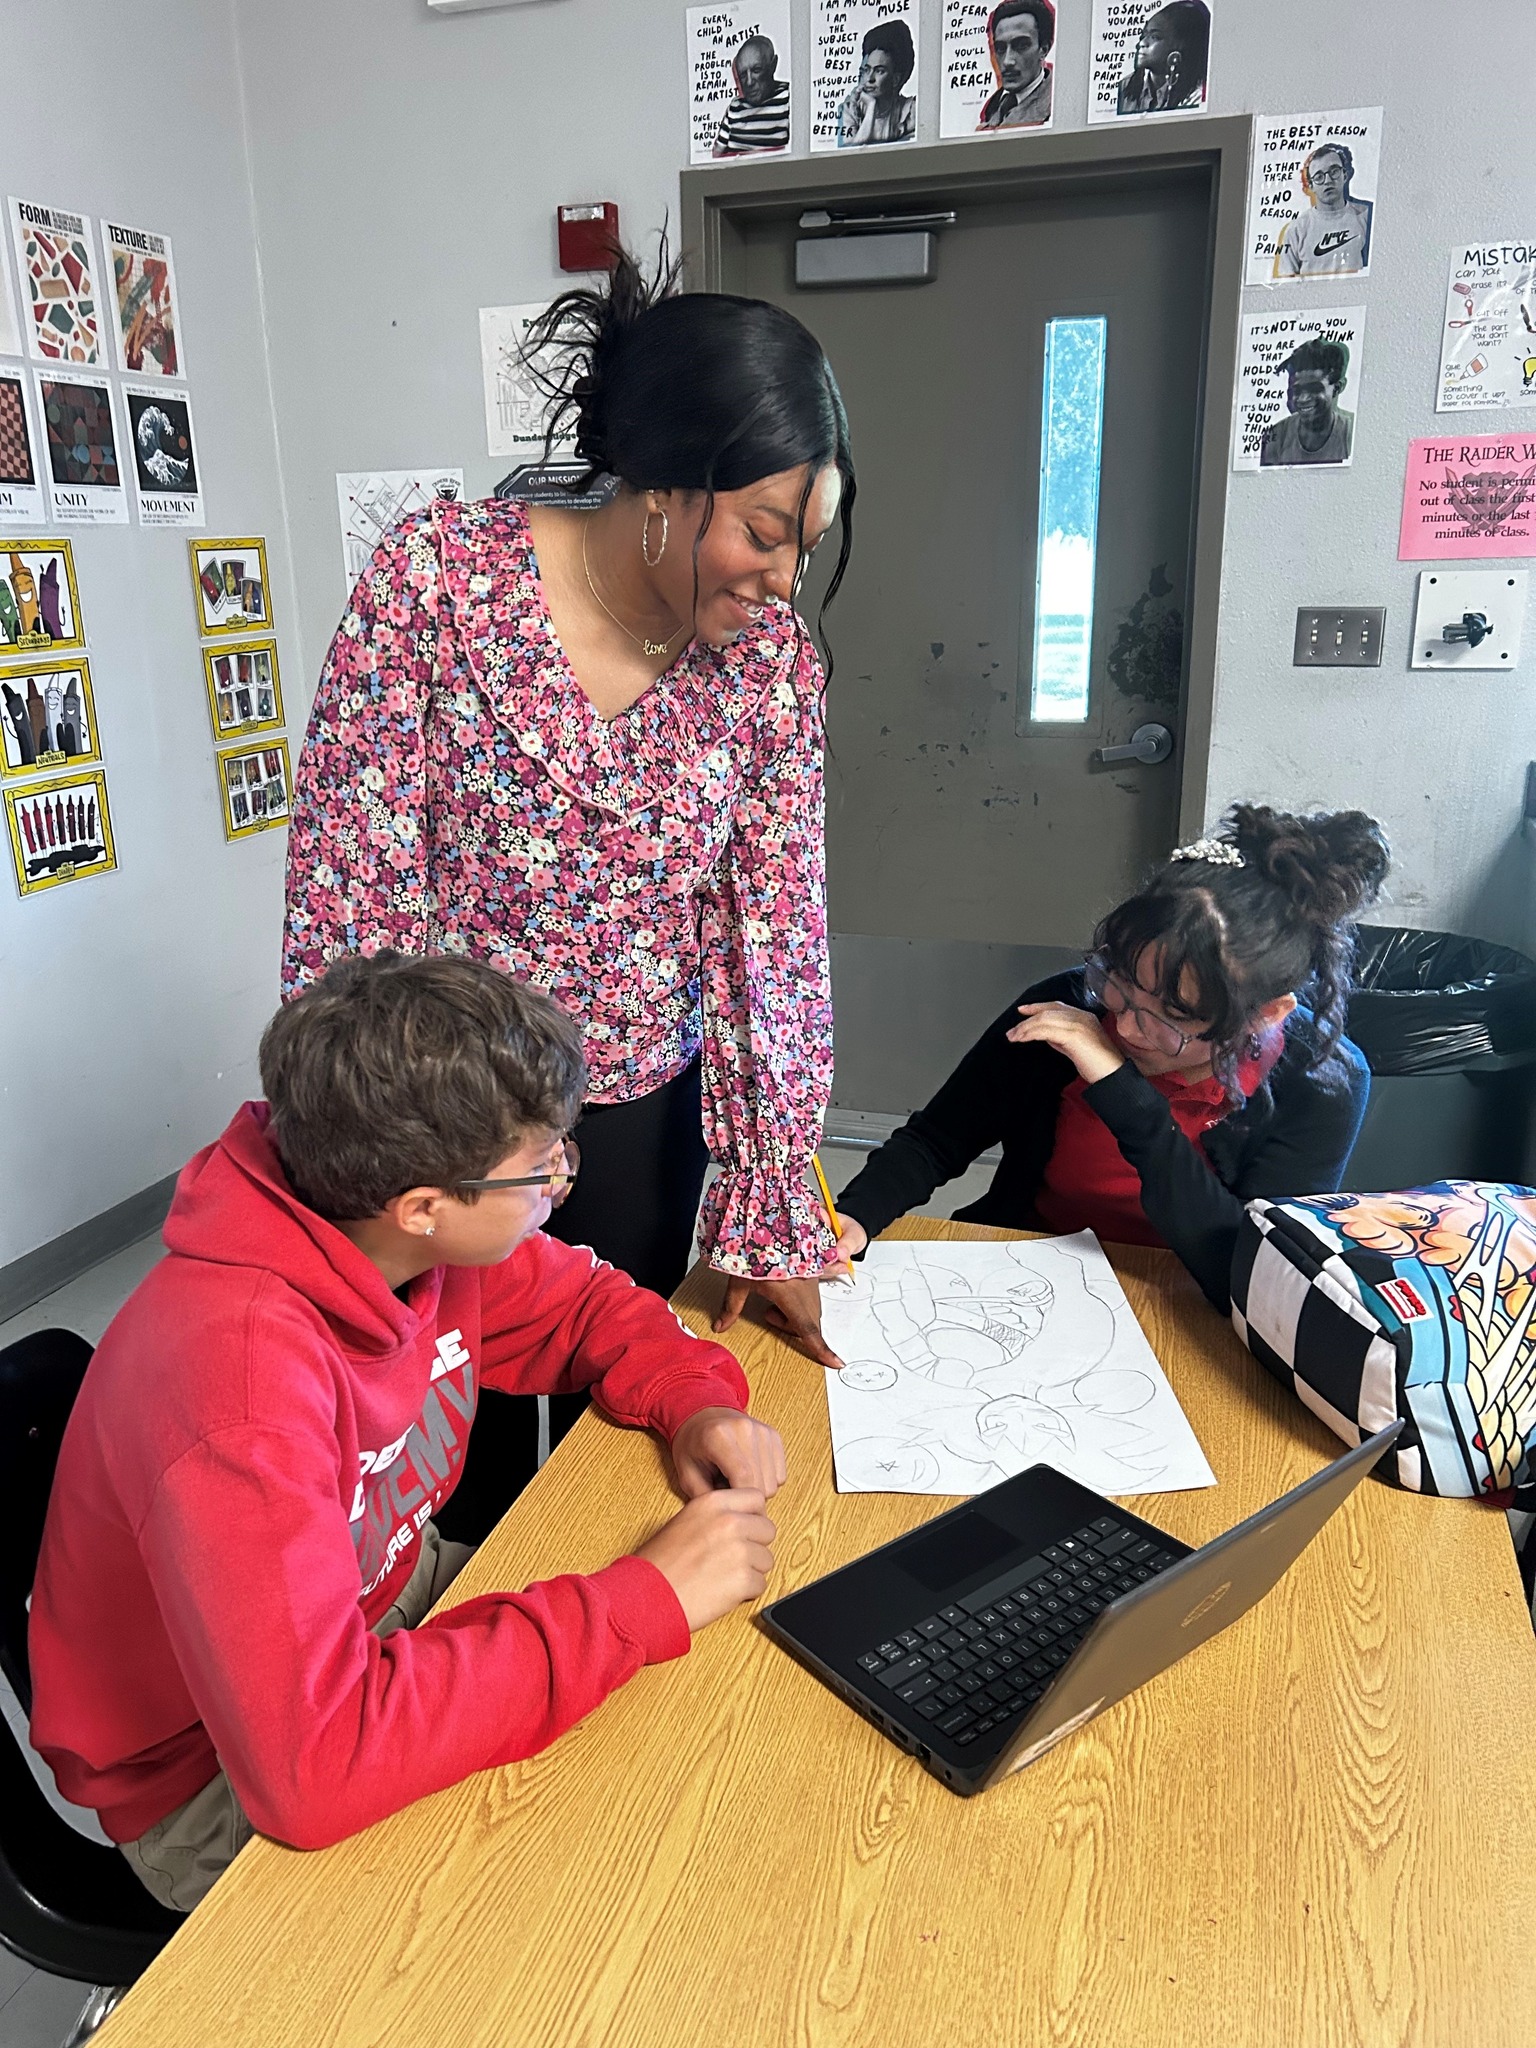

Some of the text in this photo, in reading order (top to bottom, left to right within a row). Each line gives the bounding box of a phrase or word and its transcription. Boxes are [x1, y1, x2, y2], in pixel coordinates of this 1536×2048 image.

[826, 0, 839, 9] AM
[878, 0, 909, 17] MUSE
[947, 2, 959, 12] NO
[1108, 1, 1161, 15] TO SAY WHO
[961, 5, 987, 16] FEAR
[703, 14, 732, 27] EVERY IS
[834, 14, 846, 23] AM
[951, 19, 963, 27] OF
[1108, 18, 1126, 26] YOU
[697, 27, 722, 37] CHILD
[830, 24, 844, 33] THE
[1103, 28, 1143, 40] YOU NEED
[713, 24, 760, 47] AN ARTIST
[818, 32, 858, 45] SUBJECT
[701, 51, 717, 60] THE
[824, 46, 854, 57] I KNOW
[955, 47, 985, 57] YOU'LL
[1096, 53, 1125, 62] WRITE
[695, 60, 732, 71] PROBLEM
[825, 60, 851, 71] BEST
[948, 62, 978, 72] NEVER
[1109, 62, 1122, 70] AND
[701, 71, 721, 80] IS TO
[813, 75, 862, 87] THE SUBJECT
[951, 72, 992, 88] REACH
[1094, 71, 1122, 81] PAINT
[696, 79, 727, 91] REMAIN
[694, 88, 739, 102] AN ARTIST
[818, 89, 845, 98] I WANT
[980, 90, 989, 98] IT
[1098, 92, 1110, 100] DO
[693, 113, 710, 122] ONCE
[818, 111, 842, 121] KNOW
[703, 121, 722, 130] THEY
[694, 130, 715, 140] GROW
[813, 125, 853, 138] BETTER
[1267, 126, 1367, 139] THE BEST REASON
[1264, 140, 1314, 151] TO PAINT
[1263, 162, 1300, 173] IS THAT
[1265, 172, 1293, 181] THERE
[1261, 190, 1291, 205] IS NO
[19, 202, 51, 226] FORM
[1260, 208, 1299, 220] REASON
[108, 225, 148, 249] TEXTURE
[1255, 244, 1290, 255] PAINT
[1471, 281, 1492, 289] erase
[1251, 319, 1347, 335] IT'S NOT WHO YOU
[1319, 330, 1354, 342] THINK
[1253, 340, 1294, 351] YOU ARE
[1261, 353, 1282, 361] THAT
[1243, 365, 1280, 376] HOLDS
[1256, 389, 1284, 399] BACK
[1443, 384, 1482, 393] something
[1259, 403, 1280, 411] WHO
[1248, 413, 1271, 423] YOU
[1245, 424, 1276, 434] THINK
[1424, 447, 1453, 464] THE
[1459, 445, 1514, 467] RAIDER
[529, 477, 545, 486] OUR
[1419, 480, 1437, 490] No
[1441, 479, 1483, 488] student
[1488, 477, 1497, 486] is
[55, 494, 88, 505] UNITY
[1421, 493, 1535, 506] out of class the first
[141, 500, 195, 513] MOVEMENT
[1422, 512, 1468, 522] minutes
[1489, 511, 1506, 520] the
[1511, 510, 1530, 519] last
[1435, 527, 1529, 538] minutes of class.
[643, 640, 667, 655] love
